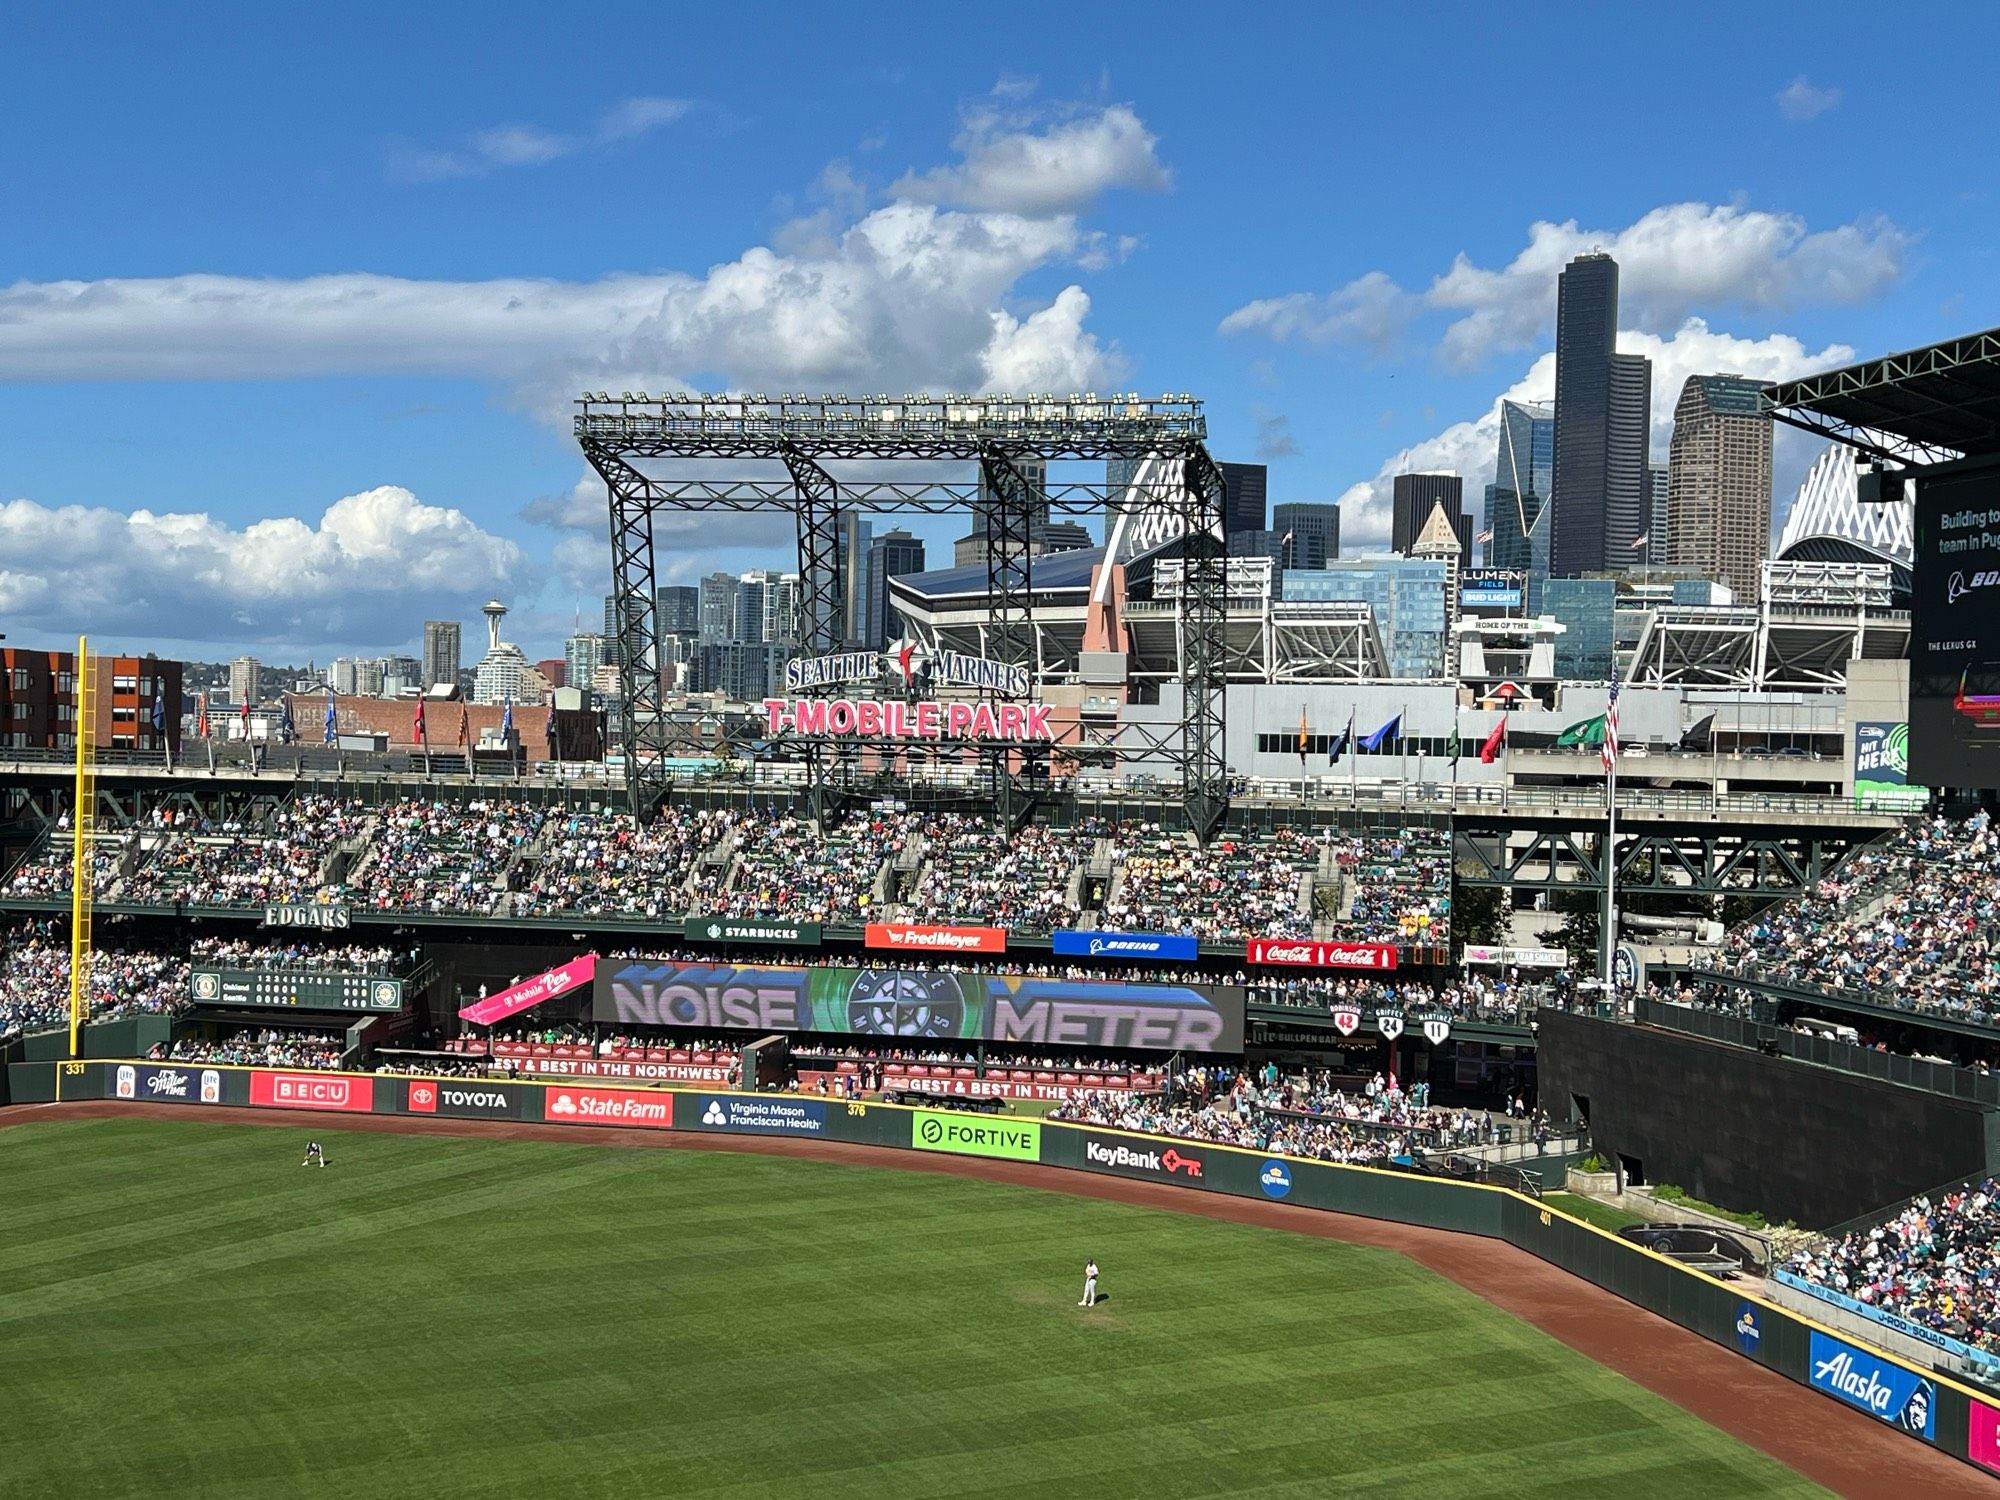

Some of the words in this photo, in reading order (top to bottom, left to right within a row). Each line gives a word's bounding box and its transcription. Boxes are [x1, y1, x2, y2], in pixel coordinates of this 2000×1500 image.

[1941, 511, 1986, 529] Building
[1939, 539, 1966, 553] team
[1969, 534, 1979, 550] in
[1463, 570, 1520, 580] LUMEN
[1488, 594, 1517, 602] LIGHT
[1928, 642, 1940, 651] THE
[1942, 641, 1964, 650] LEXUS
[1966, 640, 1976, 649] GX
[787, 650, 878, 690] SEATTLE
[931, 650, 1028, 697] MARINERS
[763, 698, 942, 738] T-MOBILE
[949, 702, 1056, 740] PARK
[1861, 740, 1878, 753] HIT
[725, 927, 798, 939] STARBUCKS
[1106, 940, 1160, 951] BOEING
[223, 983, 249, 991] Oakland
[504, 996, 512, 1007] T
[514, 985, 544, 1004] Mobile
[540, 971, 571, 993] Pen
[223, 994, 246, 1002] Seattle
[612, 982, 798, 1030] NOISE
[1330, 1005, 1361, 1014] ROBINSON
[1376, 1009, 1404, 1018] GRIFFEY
[994, 1000, 1223, 1051] METER
[1338, 1015, 1352, 1029] 42
[1384, 1019, 1397, 1032] 24
[1253, 1029, 1275, 1044] Lite
[1279, 1033, 1317, 1043] BULLPEN
[1320, 1036, 1336, 1044] BAR
[1430, 1024, 1441, 1037] 11
[66, 1064, 84, 1075] 331
[120, 1070, 132, 1080] Lite
[525, 1060, 535, 1071] &
[540, 1061, 578, 1073] BEST
[582, 1063, 596, 1074] IN
[602, 1064, 630, 1076] THE
[636, 1065, 731, 1080] NORTHWEST
[147, 1076, 188, 1094] Miller
[204, 1075, 217, 1085] Lite
[165, 1086, 186, 1096] TIME
[955, 1082, 965, 1093] &
[971, 1083, 1011, 1096] BEST
[1016, 1085, 1030, 1097] IN
[1036, 1086, 1067, 1099] THE
[442, 1090, 507, 1108] TOYOTA
[730, 1103, 768, 1116] Virginia
[771, 1105, 804, 1117] Mason
[848, 1104, 865, 1117] 376
[730, 1114, 784, 1128] Franciscan
[786, 1118, 820, 1130] Health
[948, 1126, 1032, 1149] FORTIVE
[1087, 1142, 1160, 1170] KeyBank
[1262, 1174, 1289, 1186] Corona
[1540, 1210, 1551, 1226] 401
[1737, 1320, 1759, 1339] Corona
[1878, 1314, 1906, 1330] J-ROD
[1913, 1326, 1946, 1346] SQUAD
[1815, 1352, 1892, 1410] Alaska
